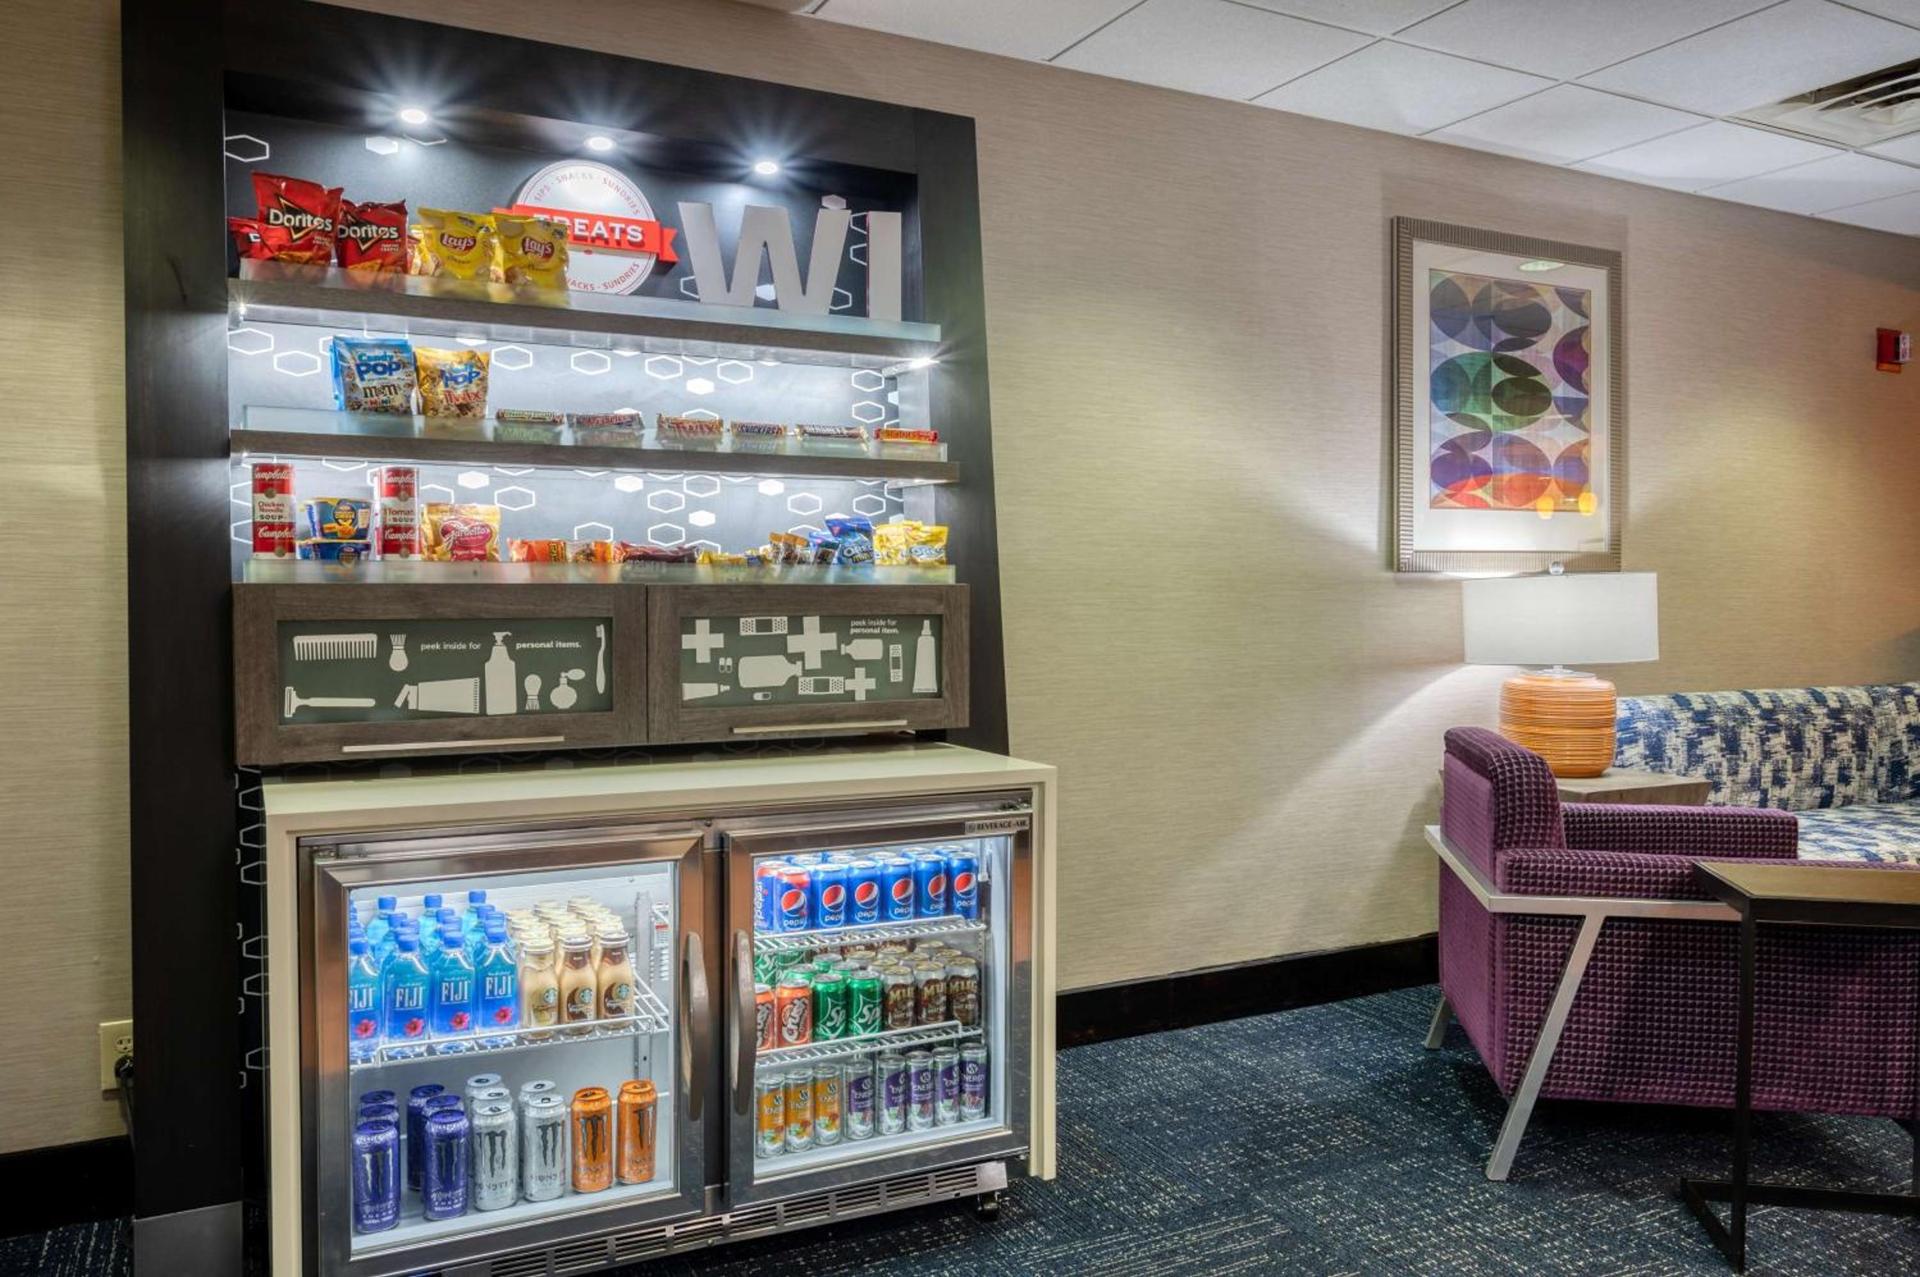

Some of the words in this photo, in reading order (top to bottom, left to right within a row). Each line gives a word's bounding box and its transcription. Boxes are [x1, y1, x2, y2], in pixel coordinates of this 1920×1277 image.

[602, 176, 641, 216] SUNDRIES
[269, 208, 333, 232] Doritos
[338, 224, 400, 240] Doritos
[442, 234, 474, 250] Lay's
[524, 237, 553, 257] Lay's
[602, 262, 640, 291] SUNDRIES
[420, 642, 441, 652] peek
[442, 641, 467, 651] inside
[469, 641, 481, 650] for
[515, 640, 555, 650] personal
[556, 640, 582, 649] items.
[396, 986, 423, 1008] FIJI
[441, 980, 469, 1002] FIJI
[485, 975, 512, 997] FIJI
